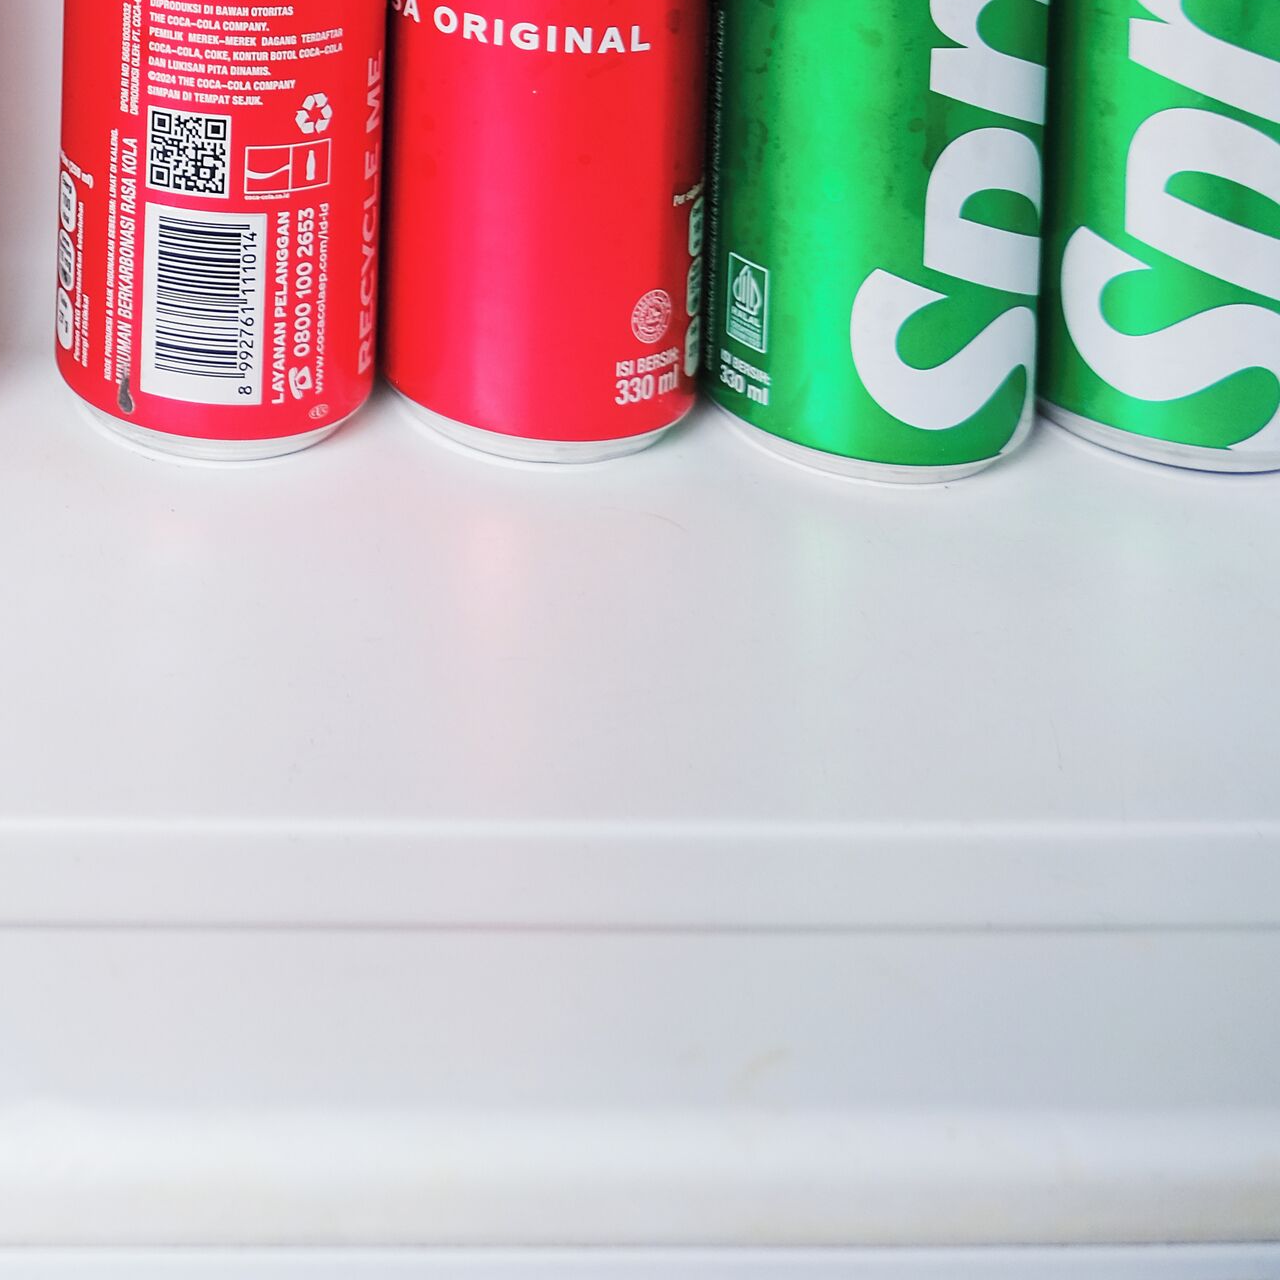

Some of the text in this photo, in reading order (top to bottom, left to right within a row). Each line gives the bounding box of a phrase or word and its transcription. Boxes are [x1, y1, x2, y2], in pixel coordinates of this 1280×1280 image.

[149, 11, 166, 24] THE
[223, 21, 270, 32] COMPANY.
[204, 5, 214, 15] DI
[216, 5, 249, 16] BAWAH
[251, 6, 294, 17] OTORITAS
[149, 26, 184, 41] PEMILIK
[261, 35, 297, 46] DAGANG
[433, 6, 651, 54] ORIGINAL
[148, 56, 271, 76] DAN LUKISAN PITA DINAMIS.
[233, 51, 269, 61] KONTUR
[270, 50, 298, 61] BOTOL
[147, 85, 263, 105] SIMPAN DI TEMPAT SEJUK.
[178, 76, 195, 87] THE
[253, 80, 296, 90] COMPANY
[121, 138, 138, 175] KOLA
[121, 177, 136, 215] RASA
[358, 50, 382, 374] RECYCLE ME
[117, 215, 136, 319] BERKARBONASI
[293, 207, 314, 357] 0800 100 2653
[271, 211, 290, 404] LAYANAN PELANGGAN
[616, 361, 634, 377] ISI
[238, 386, 252, 395] 8
[615, 364, 679, 405] 330 ml
[720, 365, 769, 406] 330 ml
